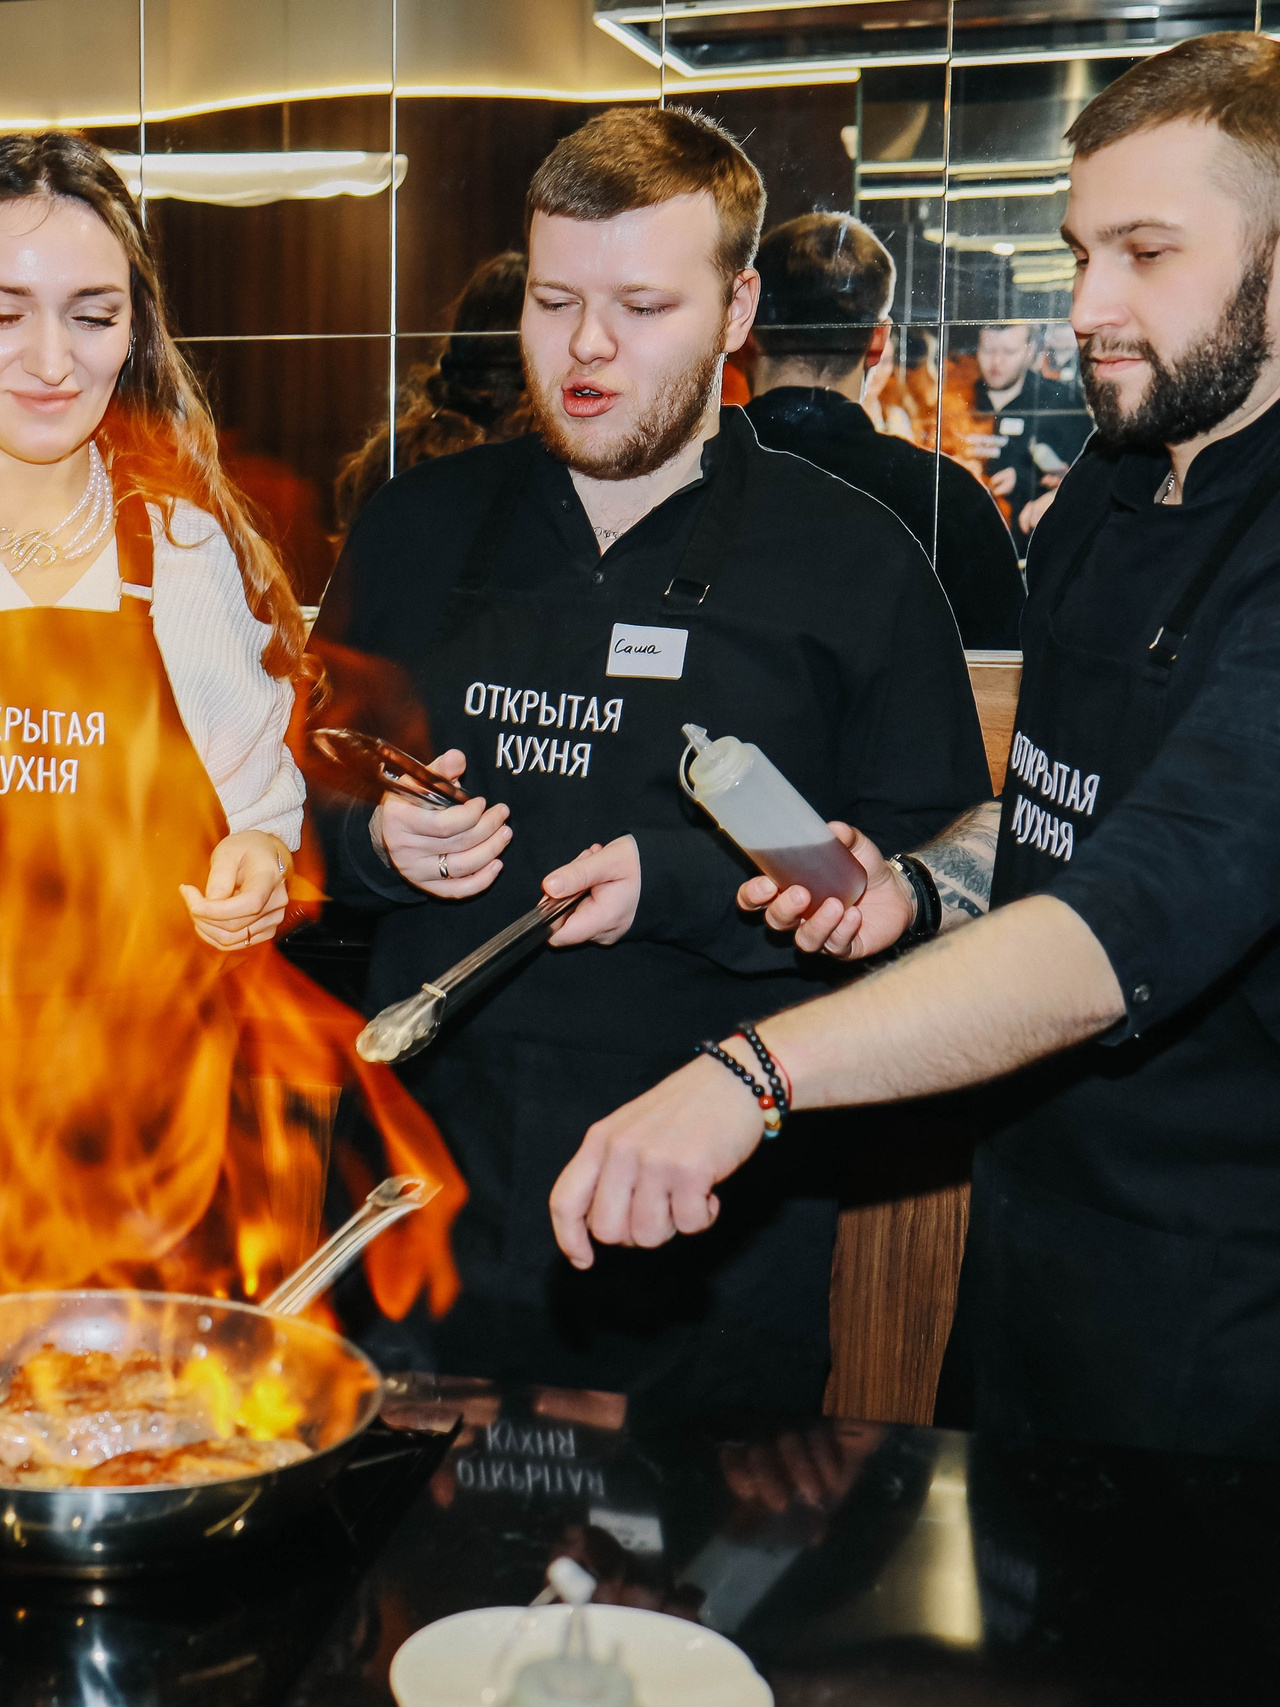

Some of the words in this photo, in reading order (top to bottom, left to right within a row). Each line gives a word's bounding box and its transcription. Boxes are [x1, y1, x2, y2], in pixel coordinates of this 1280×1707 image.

[614, 638, 662, 654] Саша
[464, 682, 624, 733] ОТКРЫТАЯ
[495, 733, 592, 778] КУХНЯ
[1010, 731, 1101, 816] ОТКРЫТАЯ
[1011, 795, 1074, 861] КУХНЯ
